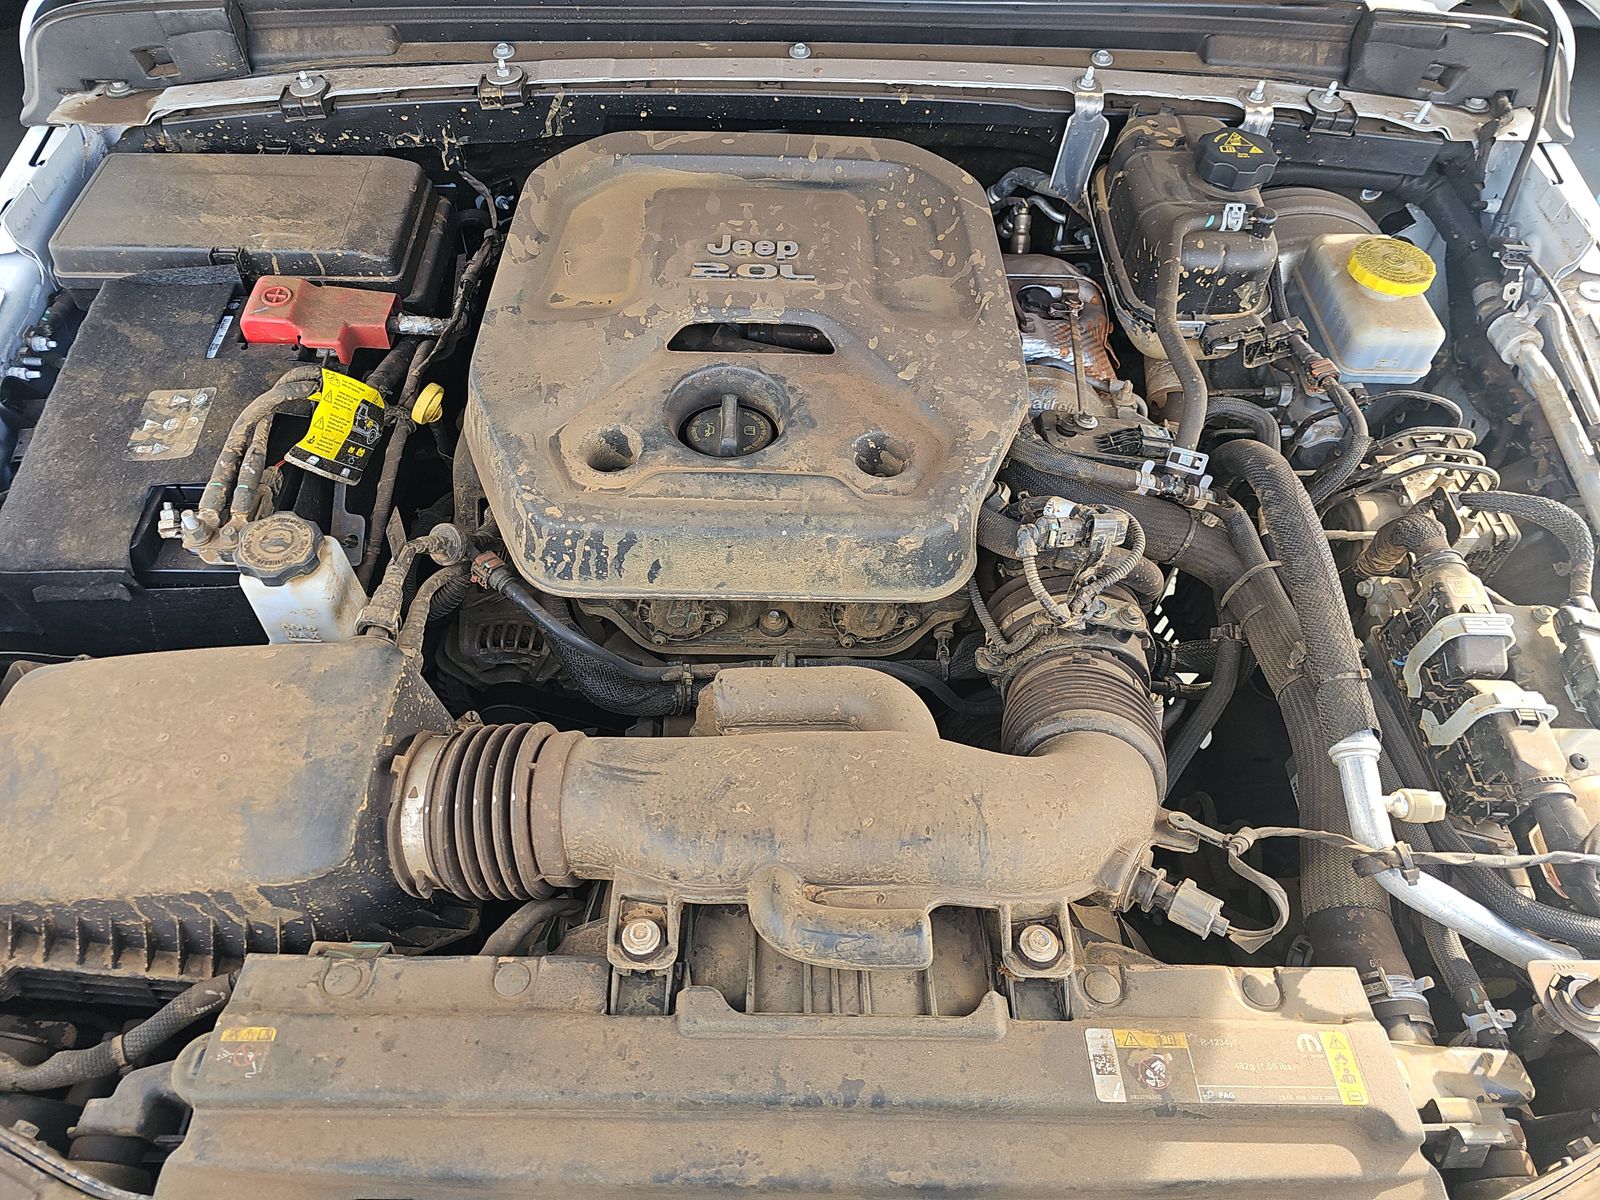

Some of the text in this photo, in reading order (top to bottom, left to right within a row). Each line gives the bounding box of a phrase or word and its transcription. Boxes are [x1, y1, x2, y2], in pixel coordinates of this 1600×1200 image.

[706, 234, 799, 261] Jeep
[691, 262, 815, 280] 2.0L
[1219, 1092, 1237, 1100] PAG
